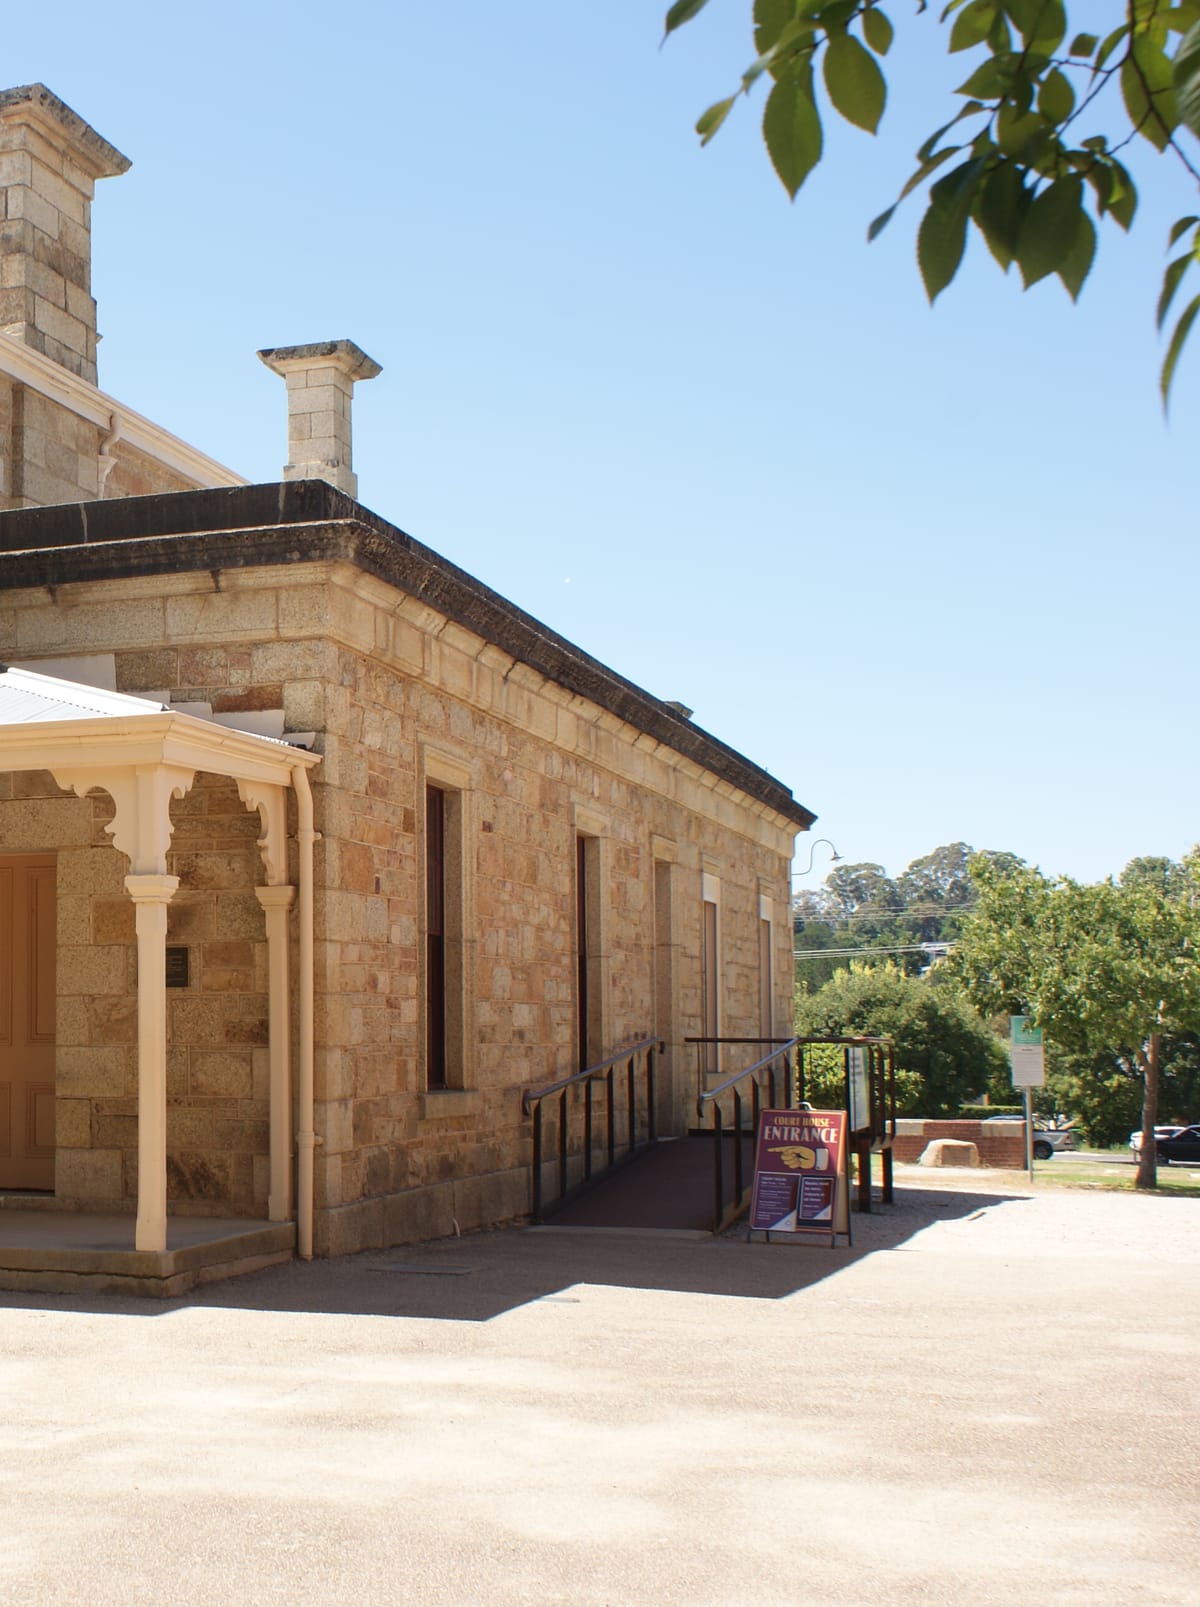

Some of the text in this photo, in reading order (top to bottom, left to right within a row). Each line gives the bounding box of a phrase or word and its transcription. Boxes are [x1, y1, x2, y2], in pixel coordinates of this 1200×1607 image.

[774, 1116, 830, 1127] COURT HOUSE
[764, 1126, 839, 1143] ENTRANCE
